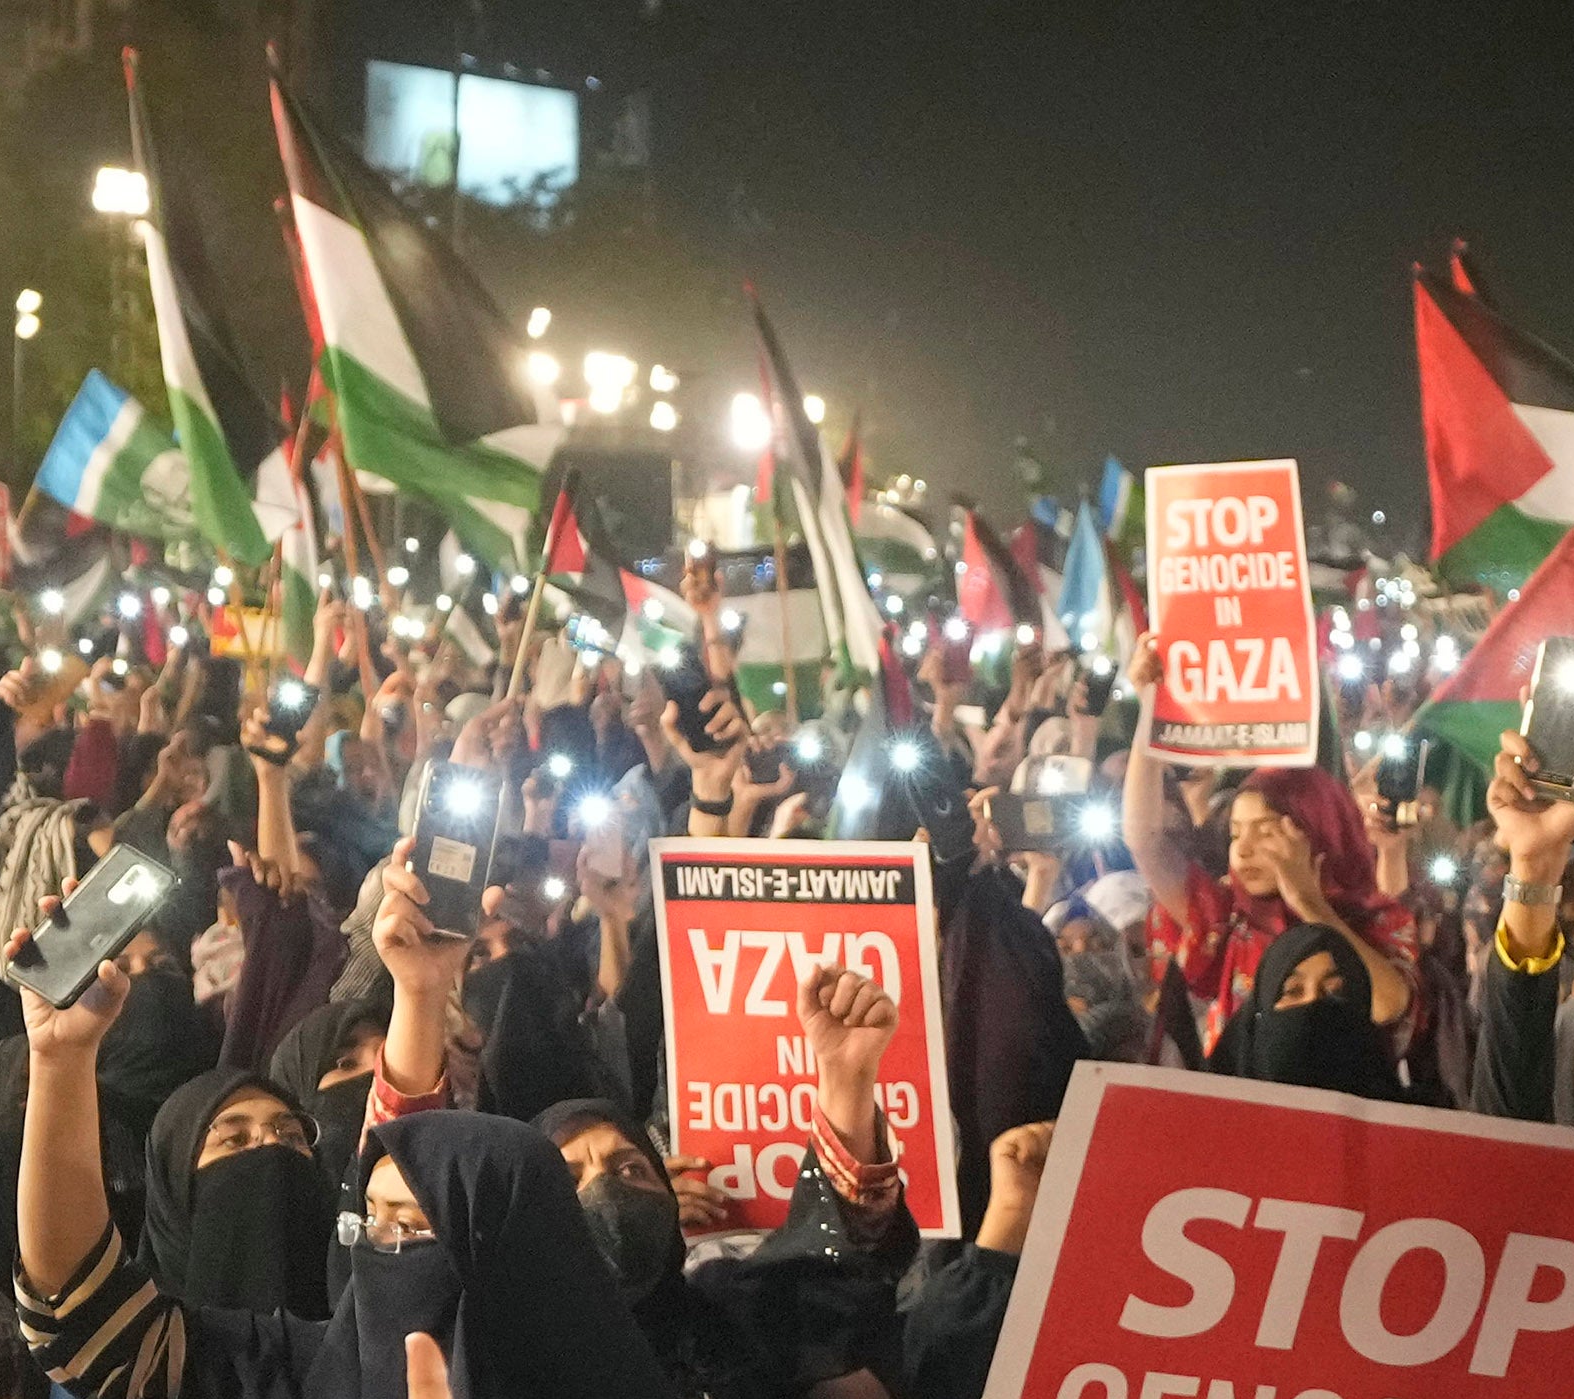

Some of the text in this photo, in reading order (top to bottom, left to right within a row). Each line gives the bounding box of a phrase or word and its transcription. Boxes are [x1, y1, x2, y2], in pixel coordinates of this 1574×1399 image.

[1166, 496, 1279, 549] STOP
[1159, 551, 1297, 594] GENOCIDE
[1214, 595, 1242, 628] IN
[1167, 637, 1302, 703] GAZA
[676, 866, 901, 900] JAMAAT-E-ISLAMI
